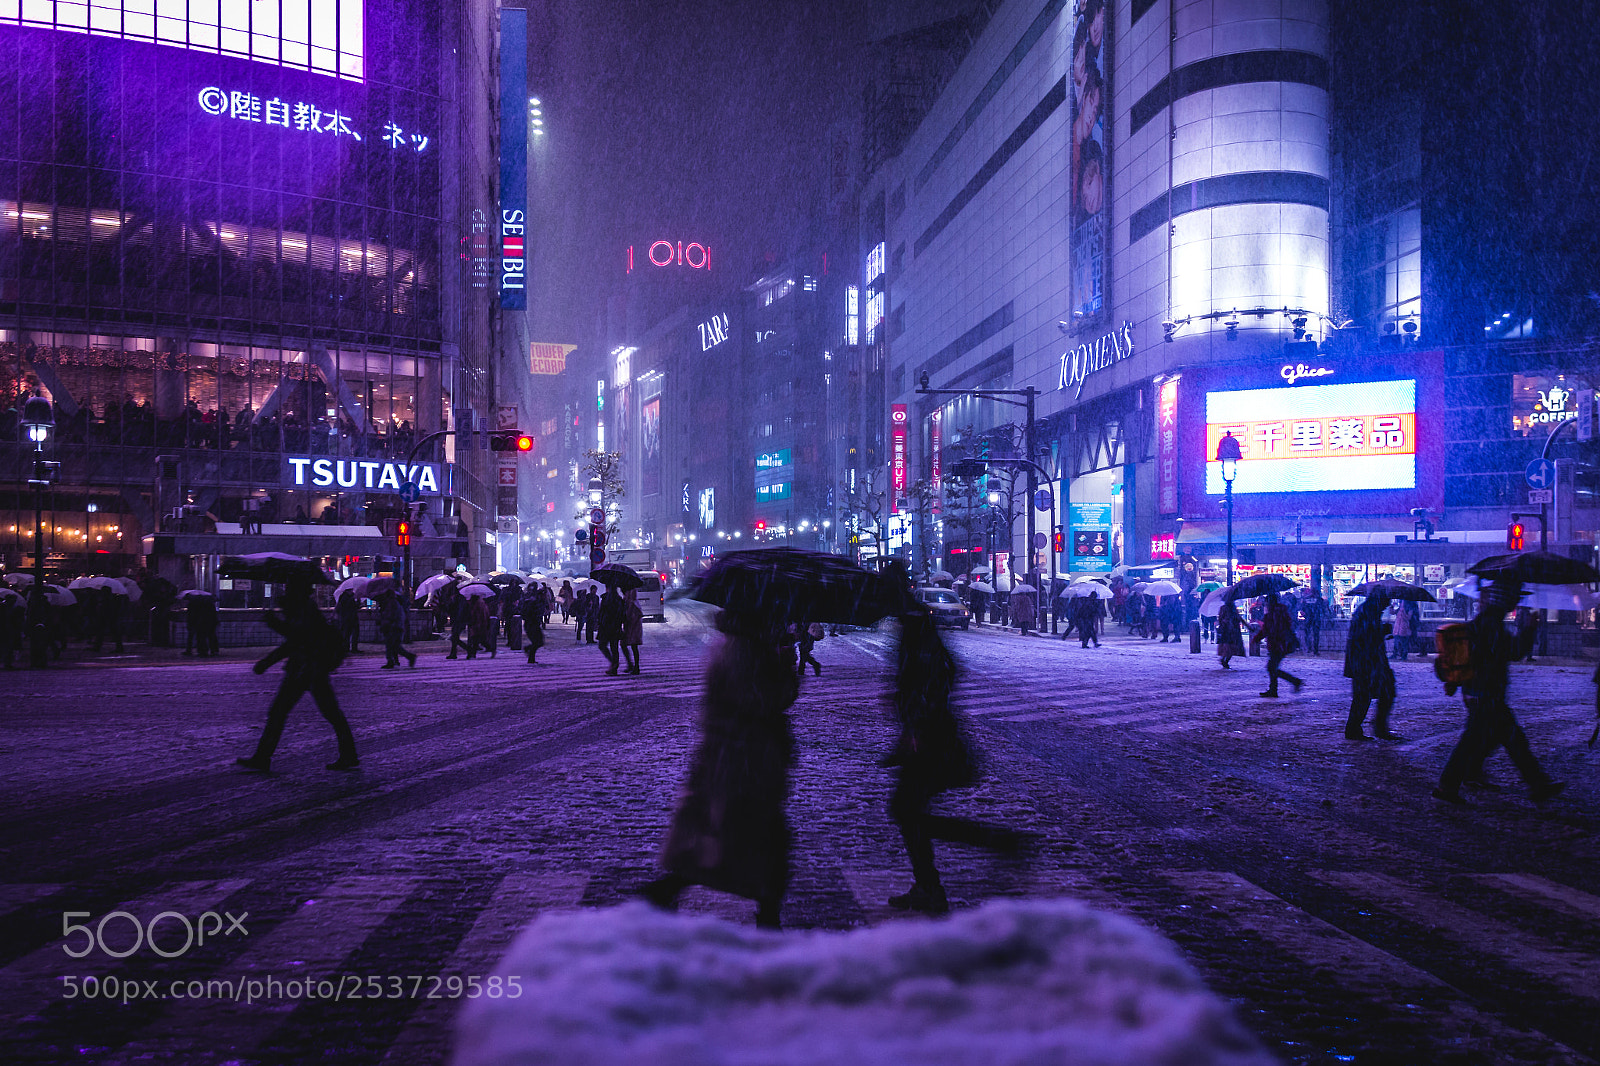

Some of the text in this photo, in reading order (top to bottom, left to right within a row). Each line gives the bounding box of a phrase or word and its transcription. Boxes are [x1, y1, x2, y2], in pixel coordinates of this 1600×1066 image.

[502, 209, 524, 289] SEIBU
[697, 312, 729, 352] ZARA
[530, 344, 564, 359] TOWER
[1280, 364, 1335, 384] Glico
[564, 404, 572, 449] KARAOKE
[1218, 417, 1405, 453] 三千里薬品
[288, 458, 438, 492] TSUTAYA
[502, 470, 515, 482] 本
[1270, 566, 1292, 574] TAX
